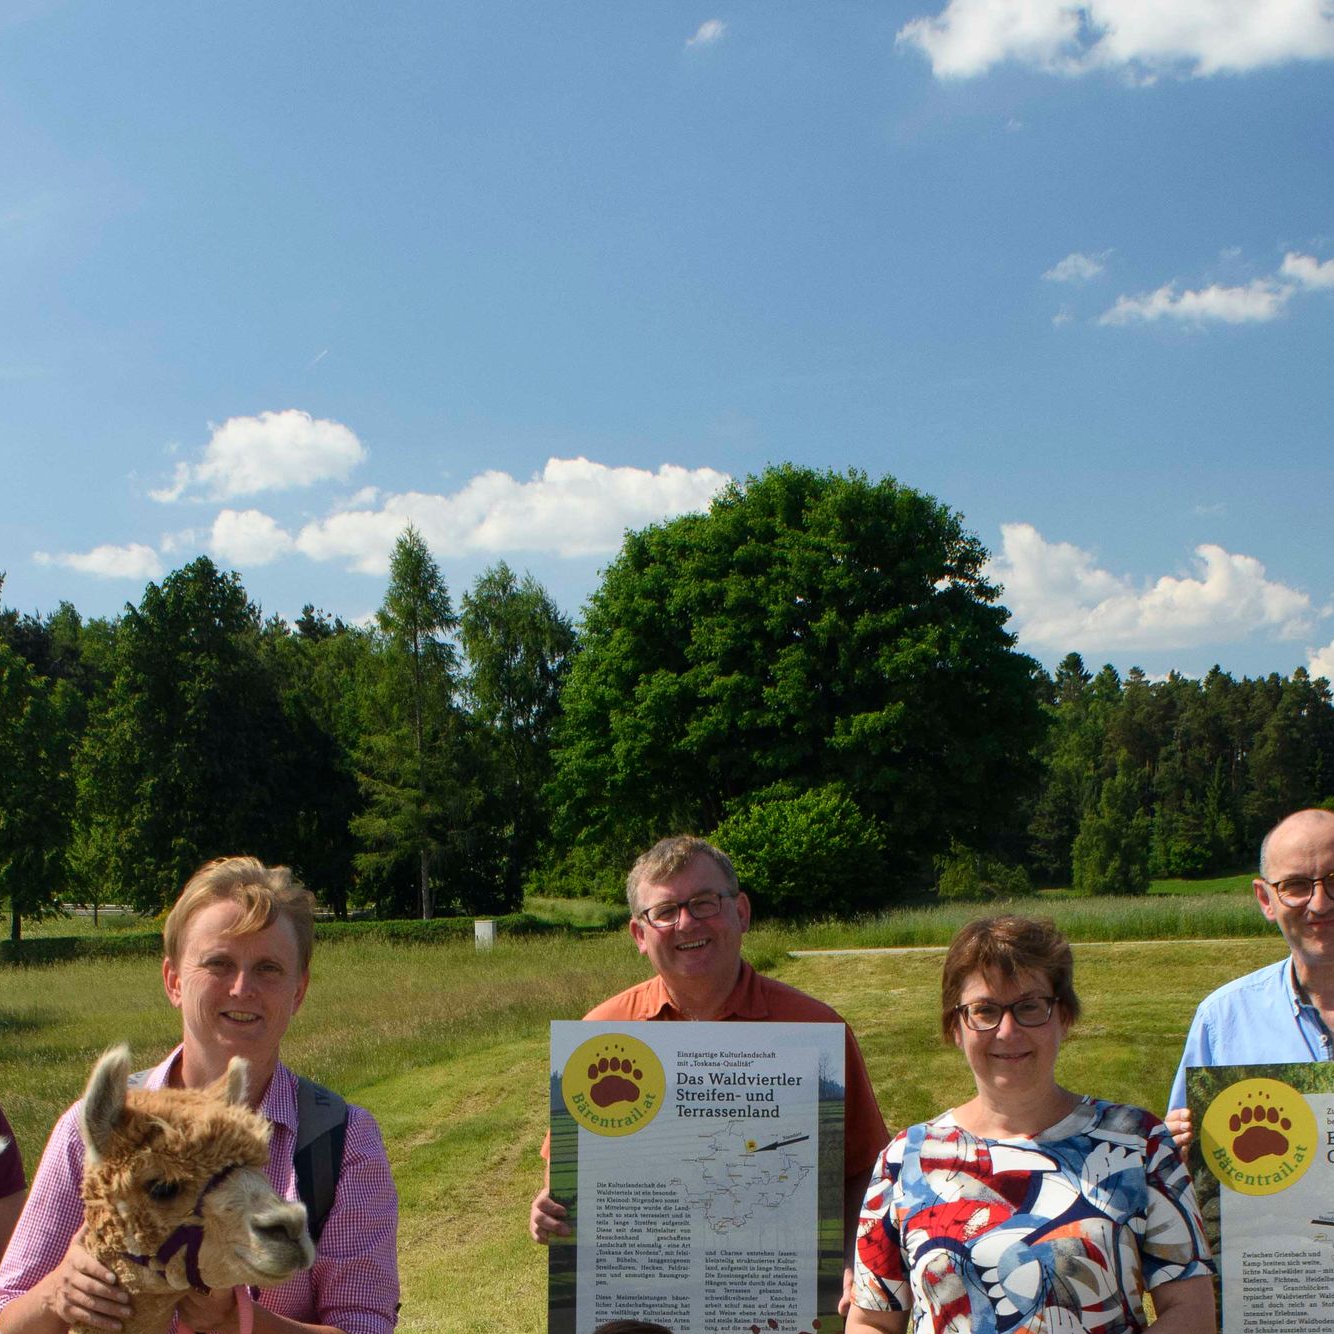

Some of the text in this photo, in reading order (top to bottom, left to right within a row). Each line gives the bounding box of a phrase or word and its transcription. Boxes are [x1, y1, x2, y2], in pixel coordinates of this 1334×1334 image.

[677, 1051, 717, 1059] Einzigartige
[676, 1072, 802, 1086] Das Waldviertler
[676, 1088, 774, 1102] Streifen- und
[571, 1091, 657, 1128] Bärentrail.at
[675, 1104, 779, 1117] Terrassenland
[1213, 1144, 1307, 1186] Bärentrail.at
